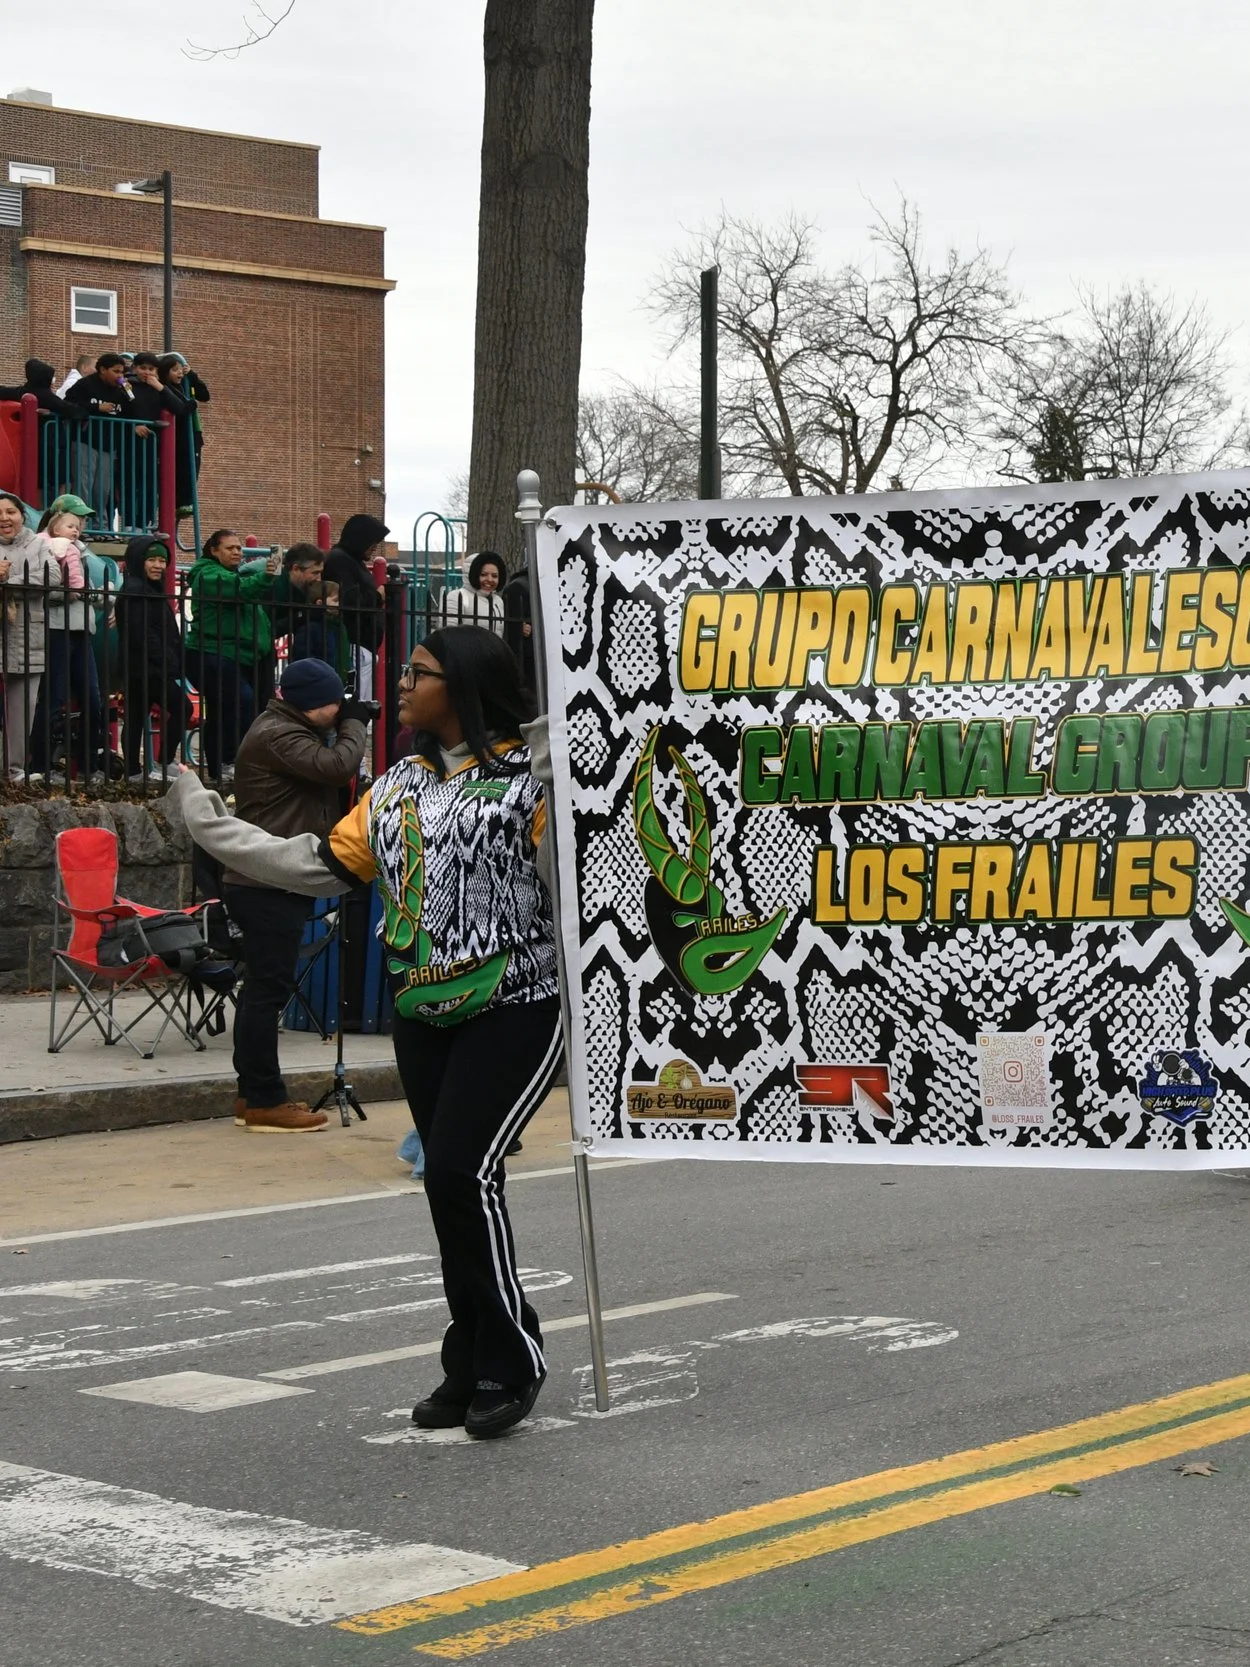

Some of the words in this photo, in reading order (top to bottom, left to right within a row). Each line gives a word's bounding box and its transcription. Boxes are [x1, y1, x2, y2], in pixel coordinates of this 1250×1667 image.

[679, 584, 873, 693] GRUPO
[741, 716, 1046, 807] CARNAVAL
[813, 843, 928, 925] LOS
[933, 837, 1198, 924] FRAILES
[631, 1091, 654, 1113] Ajo
[656, 1092, 668, 1109] &
[991, 1114, 1045, 1124] @LOSS_FRAILES
[1152, 1096, 1172, 1108] Auto
[1175, 1095, 1199, 1108] Sound
